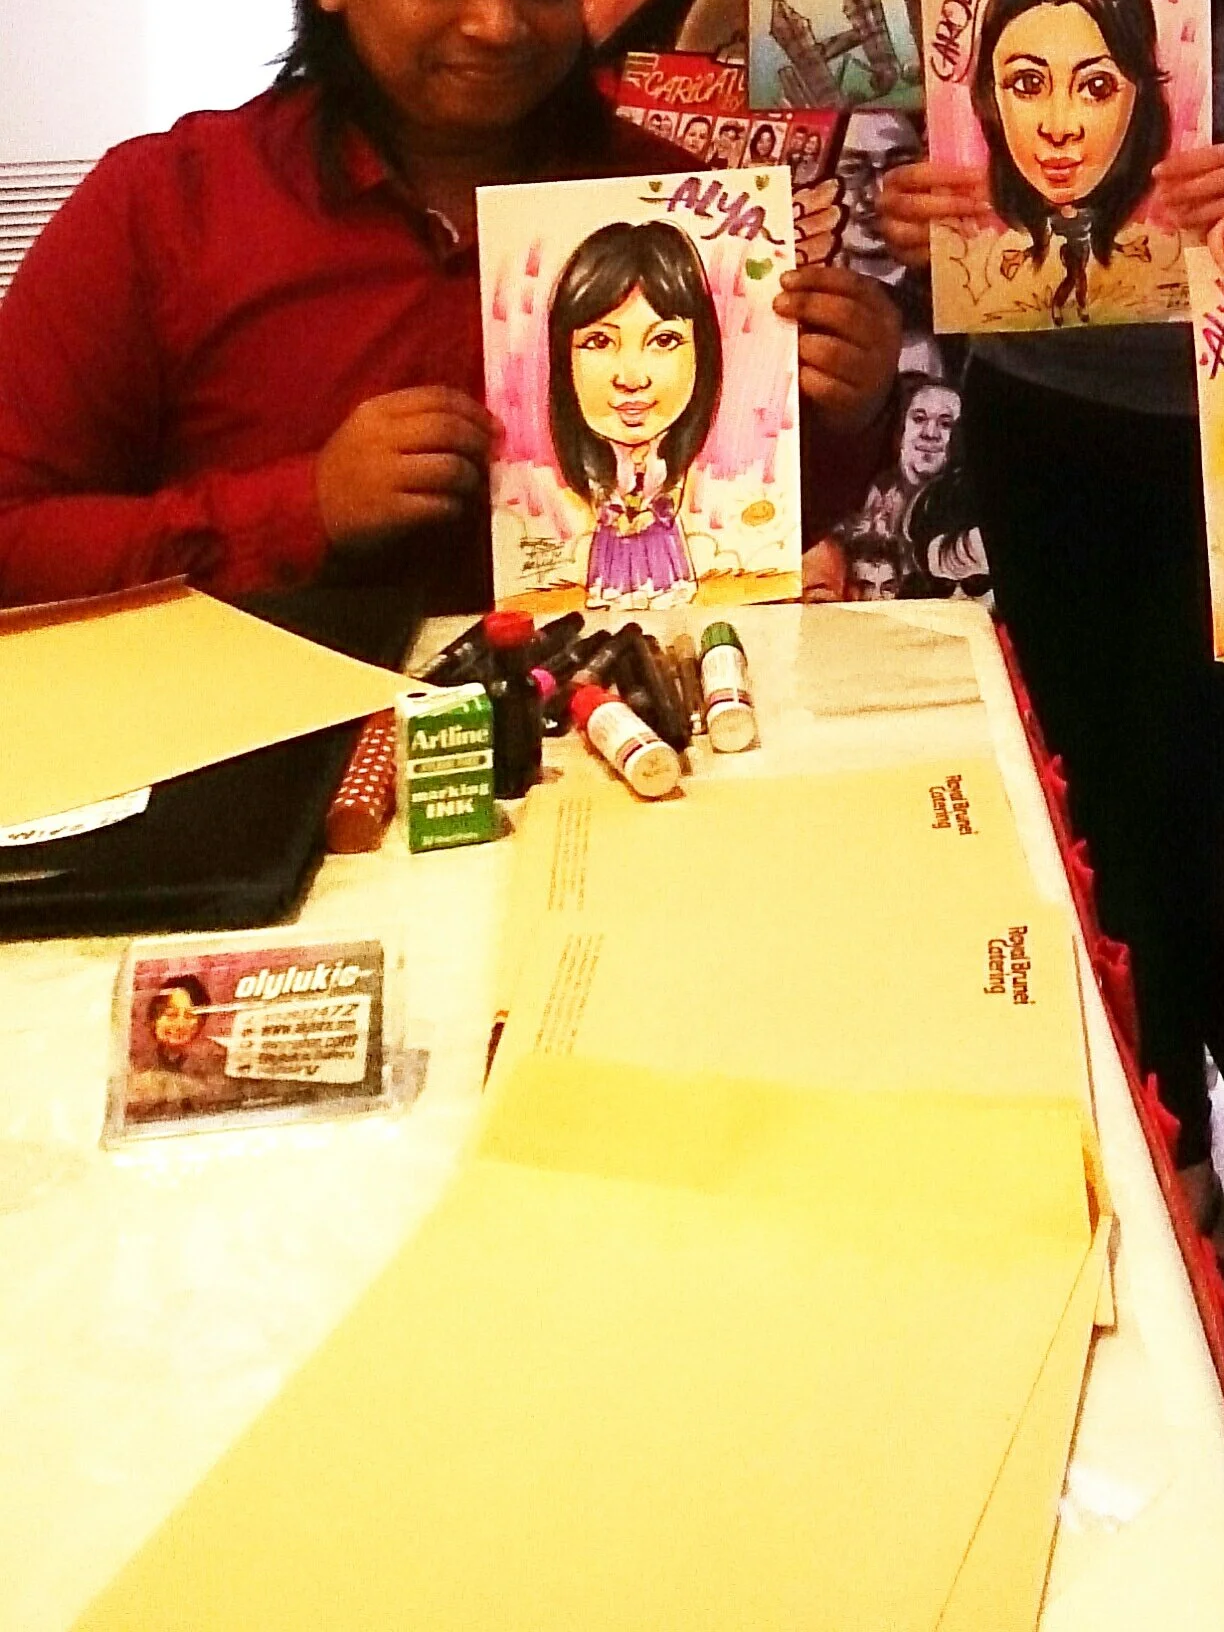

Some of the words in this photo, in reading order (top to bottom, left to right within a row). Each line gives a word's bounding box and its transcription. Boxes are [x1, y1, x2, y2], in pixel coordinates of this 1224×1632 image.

[411, 724, 490, 751] Artline
[945, 774, 967, 801] Royal
[425, 798, 475, 819] INK
[928, 786, 951, 829] Catering
[952, 801, 979, 835] Brunei
[1008, 925, 1031, 960] Royal
[983, 939, 1008, 994] Catering
[1010, 961, 1036, 1005] Brunei
